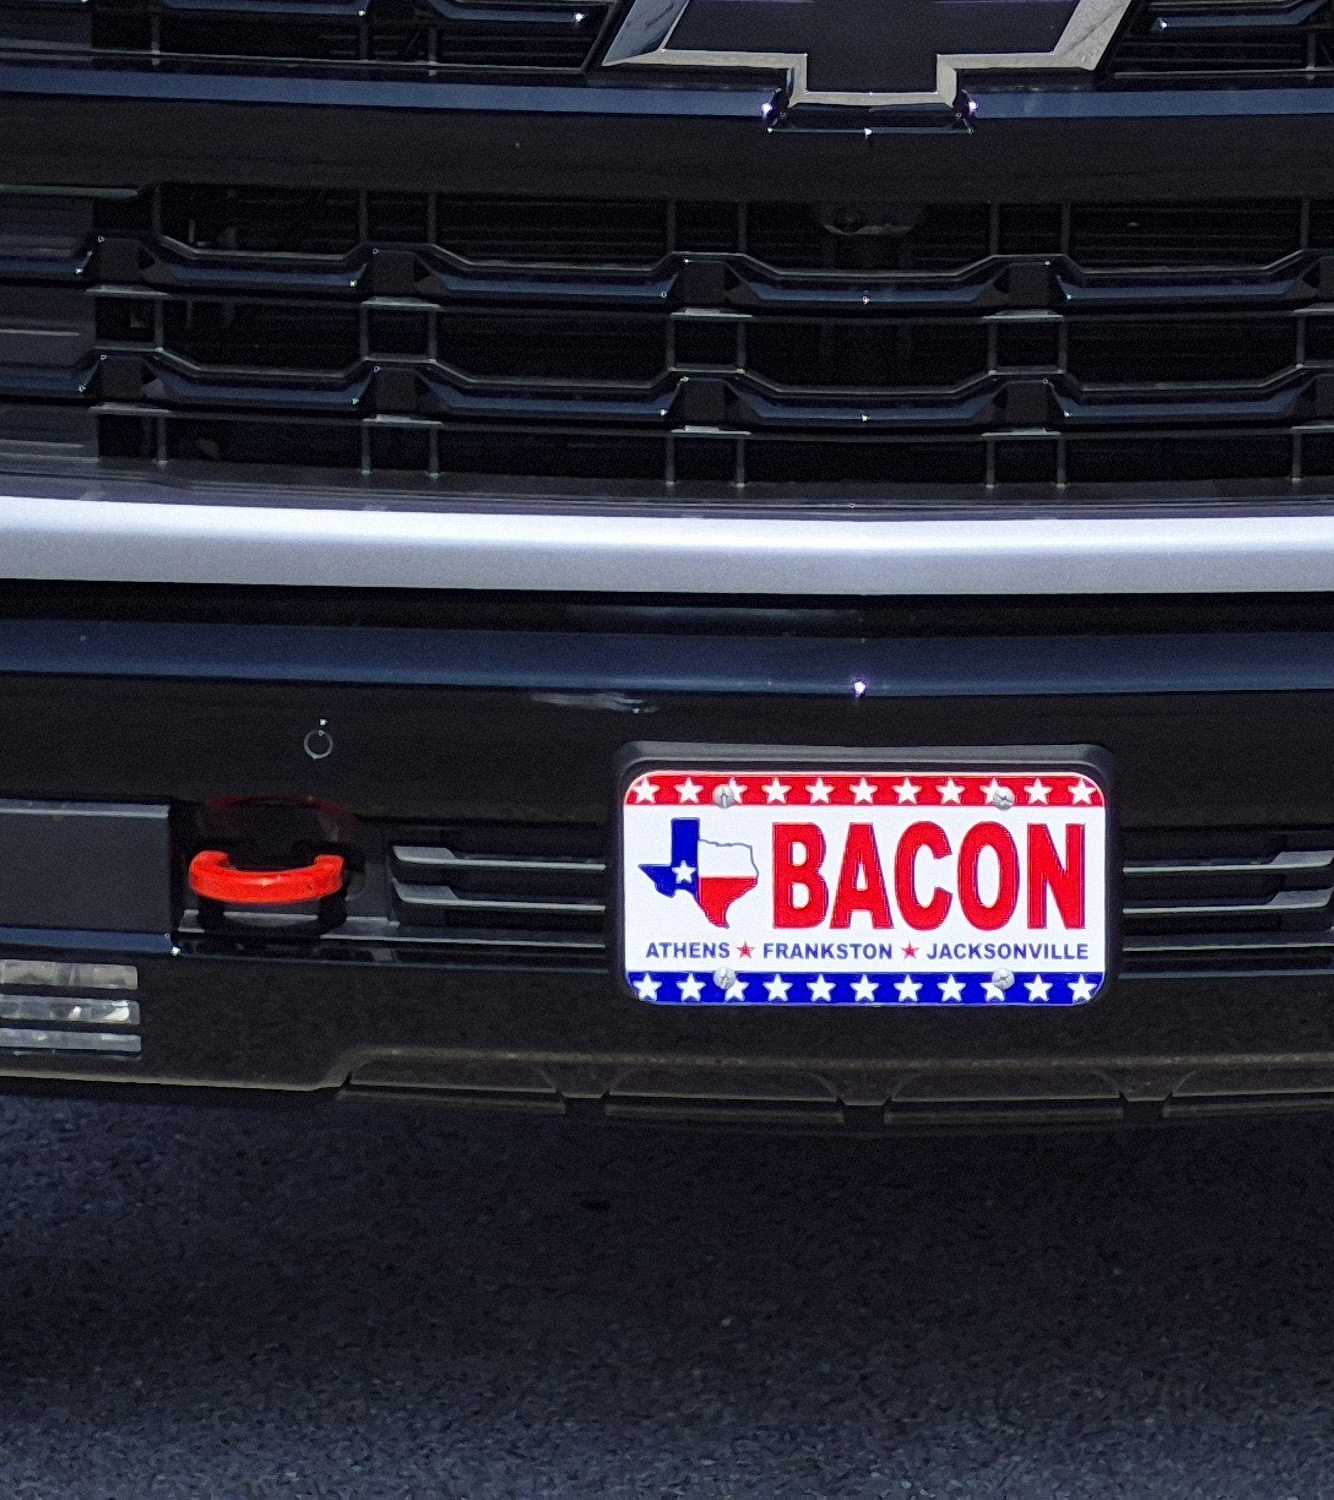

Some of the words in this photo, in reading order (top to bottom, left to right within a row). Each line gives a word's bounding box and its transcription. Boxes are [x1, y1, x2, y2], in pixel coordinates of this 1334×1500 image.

[772, 820, 1086, 931] BACON
[645, 942, 731, 959] ATHENS
[763, 942, 893, 960] FRANKSTON
[926, 942, 1089, 960] JACKSONVILLE
